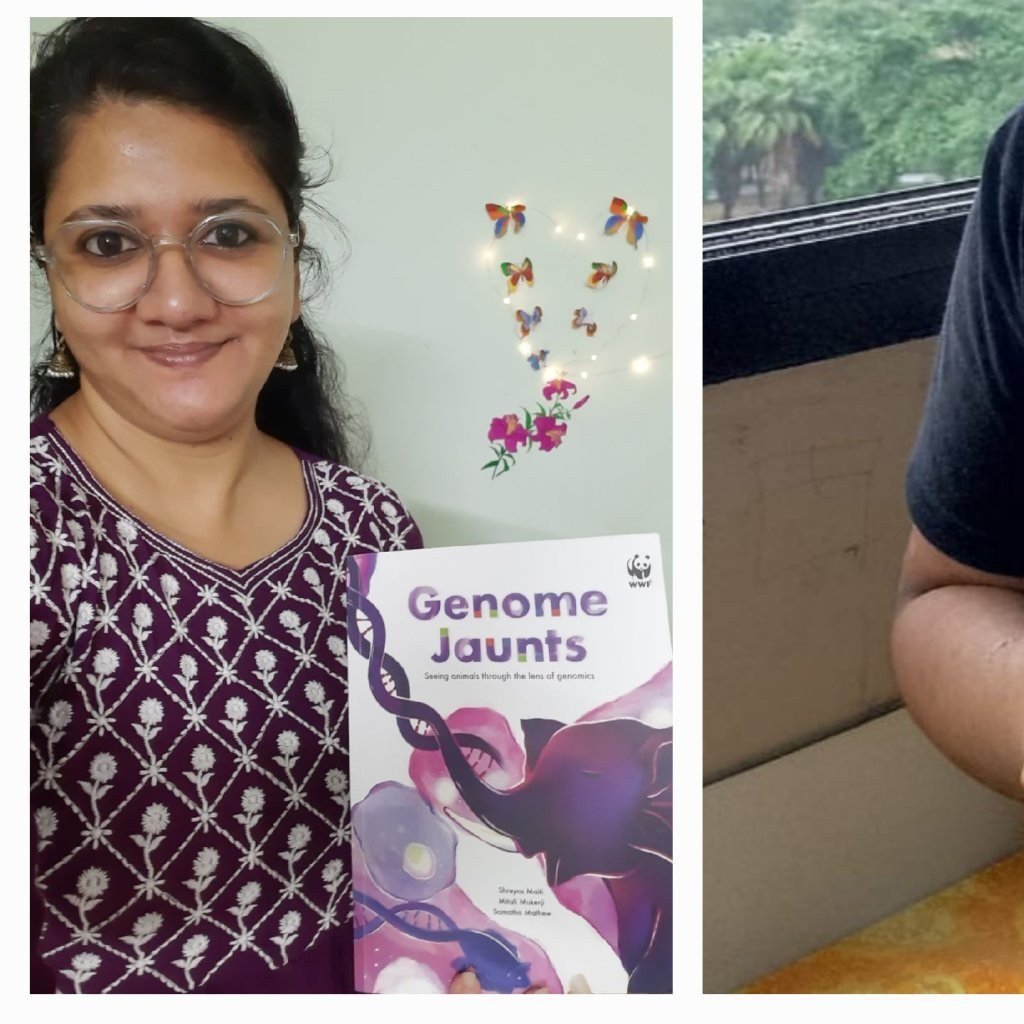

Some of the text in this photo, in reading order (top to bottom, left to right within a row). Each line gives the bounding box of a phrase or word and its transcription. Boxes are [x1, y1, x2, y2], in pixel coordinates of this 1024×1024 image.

[628, 580, 652, 588] WWF
[408, 585, 608, 621] Genome
[431, 627, 587, 663] Jaunts
[424, 672, 595, 682] Seeing animals through the lens of genomics
